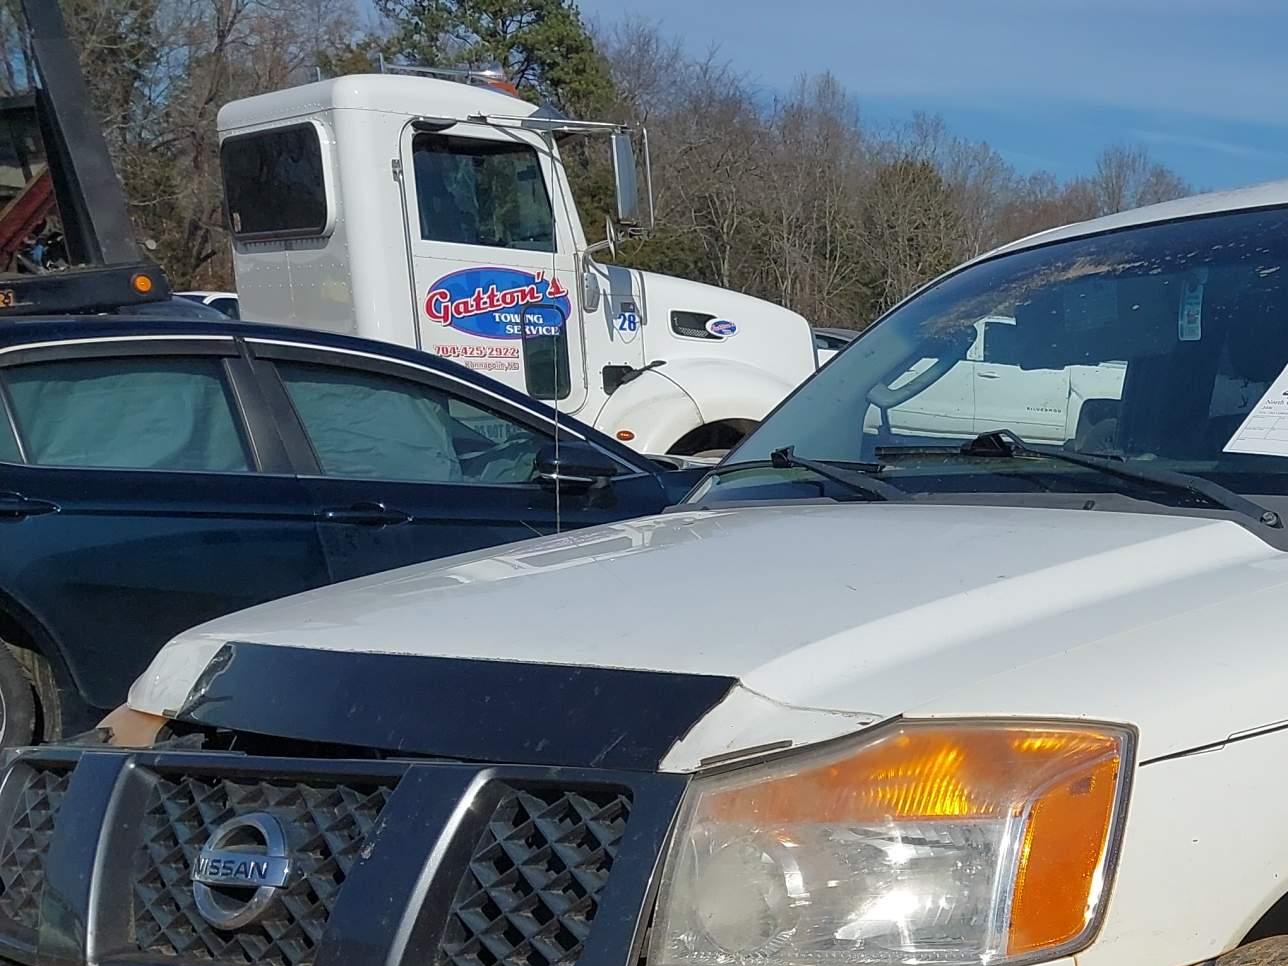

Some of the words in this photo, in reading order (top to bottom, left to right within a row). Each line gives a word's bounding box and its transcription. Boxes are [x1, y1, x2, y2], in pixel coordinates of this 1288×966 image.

[424, 269, 568, 325] Gatton's
[493, 313, 544, 324] TOWNG
[194, 858, 269, 880] NISSAN
